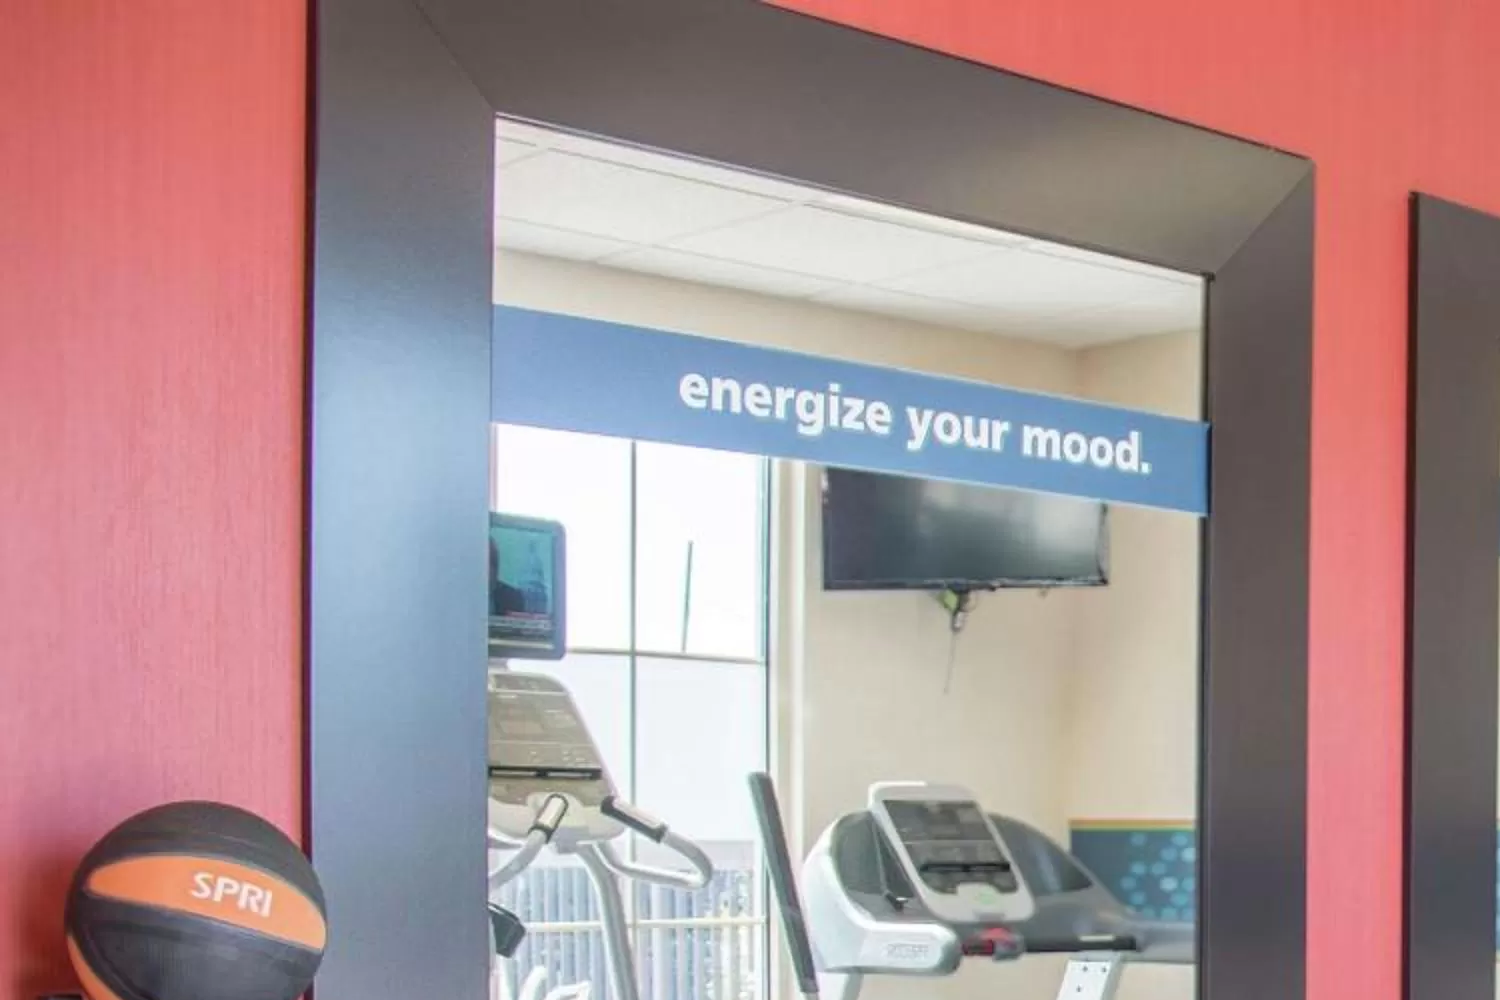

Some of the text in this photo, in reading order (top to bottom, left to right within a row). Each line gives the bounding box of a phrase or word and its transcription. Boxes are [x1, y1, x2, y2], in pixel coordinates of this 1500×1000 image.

[679, 373, 1151, 474] energize your mood.
[190, 872, 273, 918] SPRI
